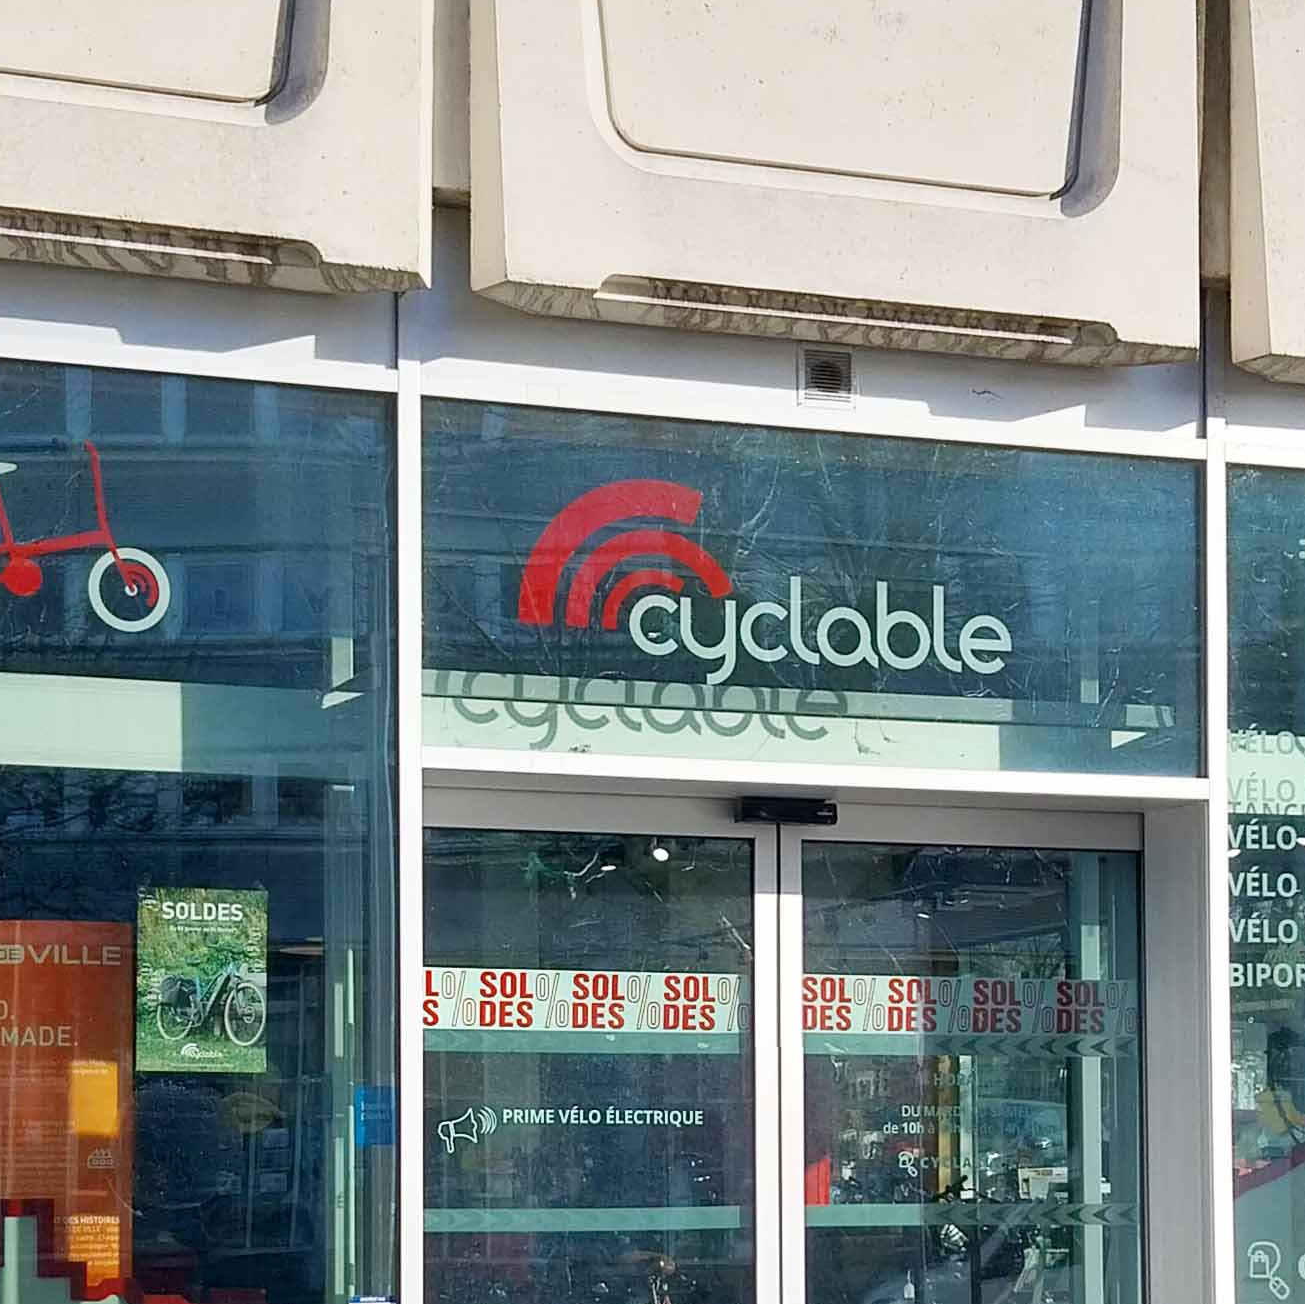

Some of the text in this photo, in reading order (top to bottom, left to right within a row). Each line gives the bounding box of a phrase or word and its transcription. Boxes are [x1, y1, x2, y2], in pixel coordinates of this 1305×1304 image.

[628, 575, 1013, 685] cyclable
[1228, 772, 1296, 803] VÉLO
[1228, 818, 1296, 851] VÉLO
[1228, 866, 1298, 898] VÉLO
[161, 901, 244, 922] SOLDES
[1228, 911, 1298, 944] VÉLO
[27, 945, 122, 965] VILLE
[479, 971, 533, 999] SOL
[572, 973, 625, 1001] SOL
[664, 975, 716, 1003] SOL
[802, 976, 851, 1004] SOL
[888, 978, 937, 1005] SOL
[973, 980, 1023, 1007] SOL
[1056, 981, 1105, 1008] SOL
[479, 1000, 534, 1028] DES
[571, 1002, 625, 1030] DES
[663, 1004, 716, 1031] DES
[802, 1005, 1105, 1035] DES DES DES DES
[1, 1025, 79, 1047] MADE.
[502, 1105, 704, 1128] PRIME VÉLO ÉLECTRIQUE
[901, 1105, 921, 1118] DU
[882, 1121, 899, 1135] de
